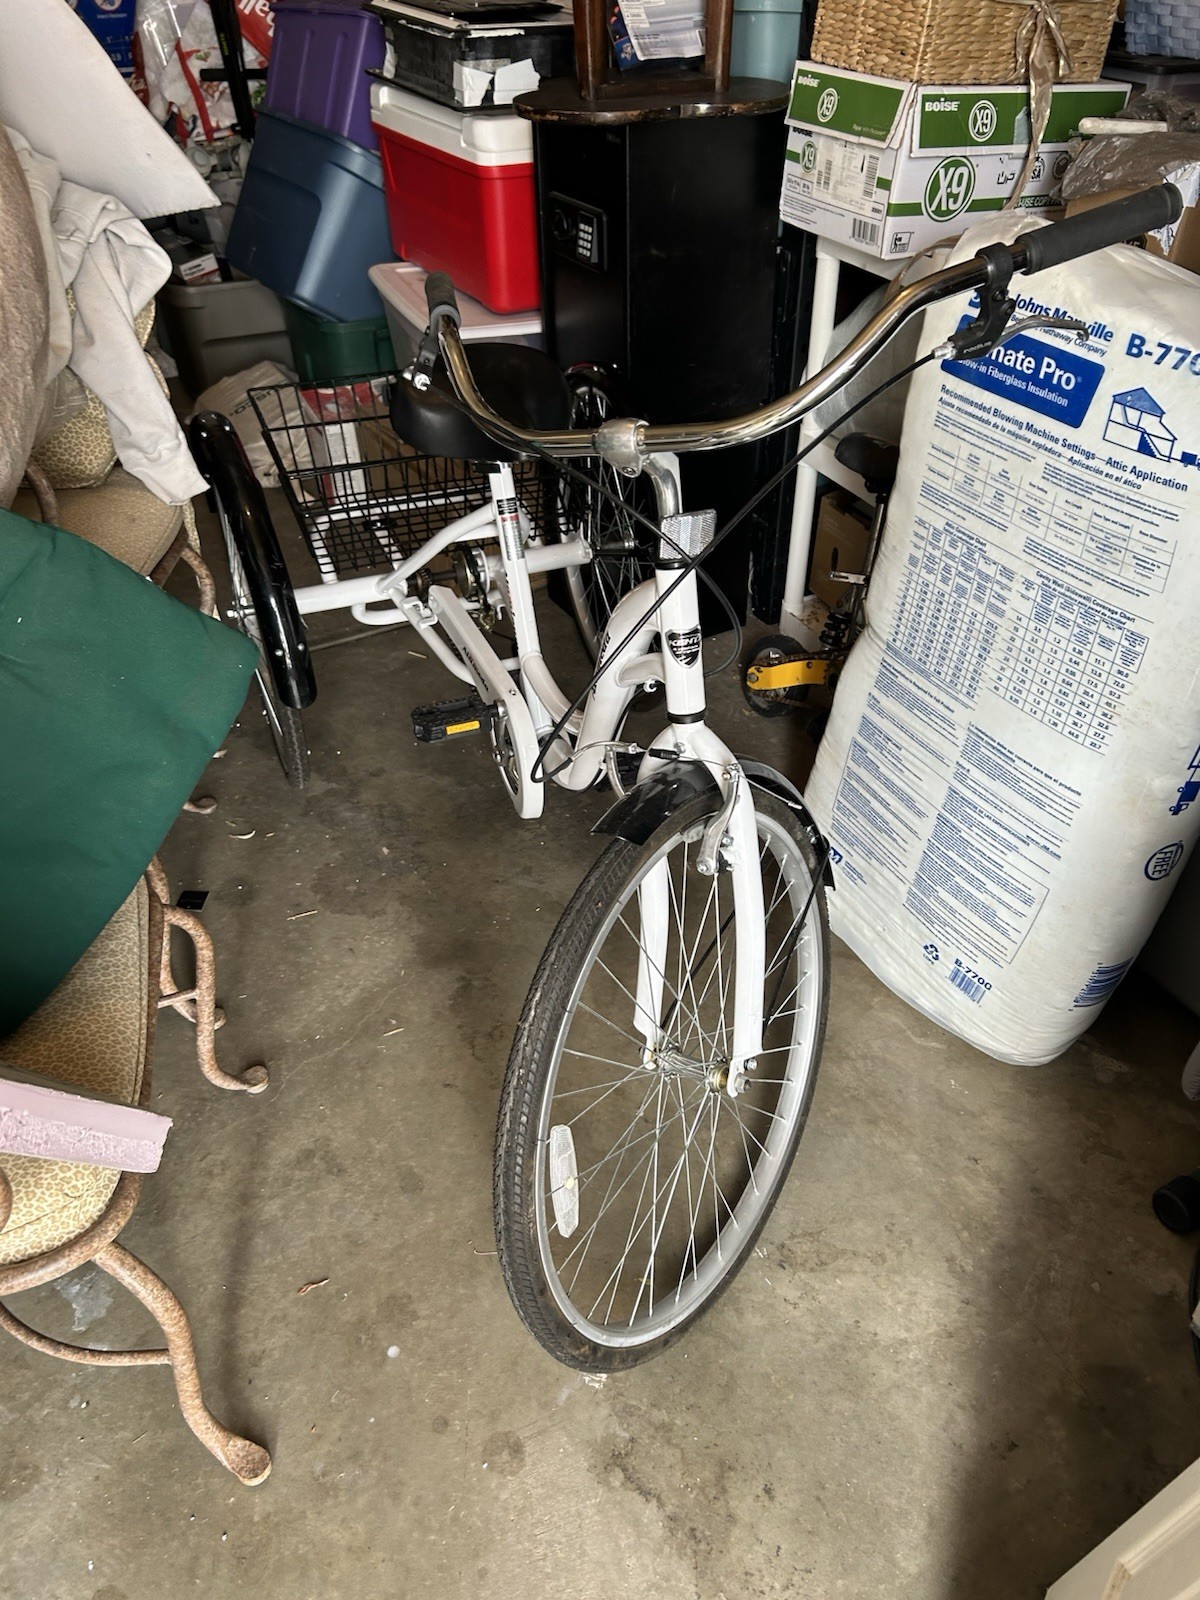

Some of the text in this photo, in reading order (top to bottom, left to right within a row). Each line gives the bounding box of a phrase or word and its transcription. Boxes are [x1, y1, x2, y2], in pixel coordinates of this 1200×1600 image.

[985, 365, 1028, 390] Fiberglass
[1025, 381, 1070, 407] Insulation
[1035, 355, 1081, 392] Pro
[937, 396, 956, 409] Ajuste
[954, 405, 992, 426] recomendado
[991, 422, 1000, 430] de
[1104, 471, 1113, 479] en
[1114, 474, 1122, 482] el
[1122, 477, 1142, 490] ático
[938, 384, 994, 414] Recommended
[990, 408, 1025, 430] Blowing
[1023, 422, 1061, 444] Machine
[1128, 462, 1189, 496] Application
[951, 957, 995, 991] B-7700
